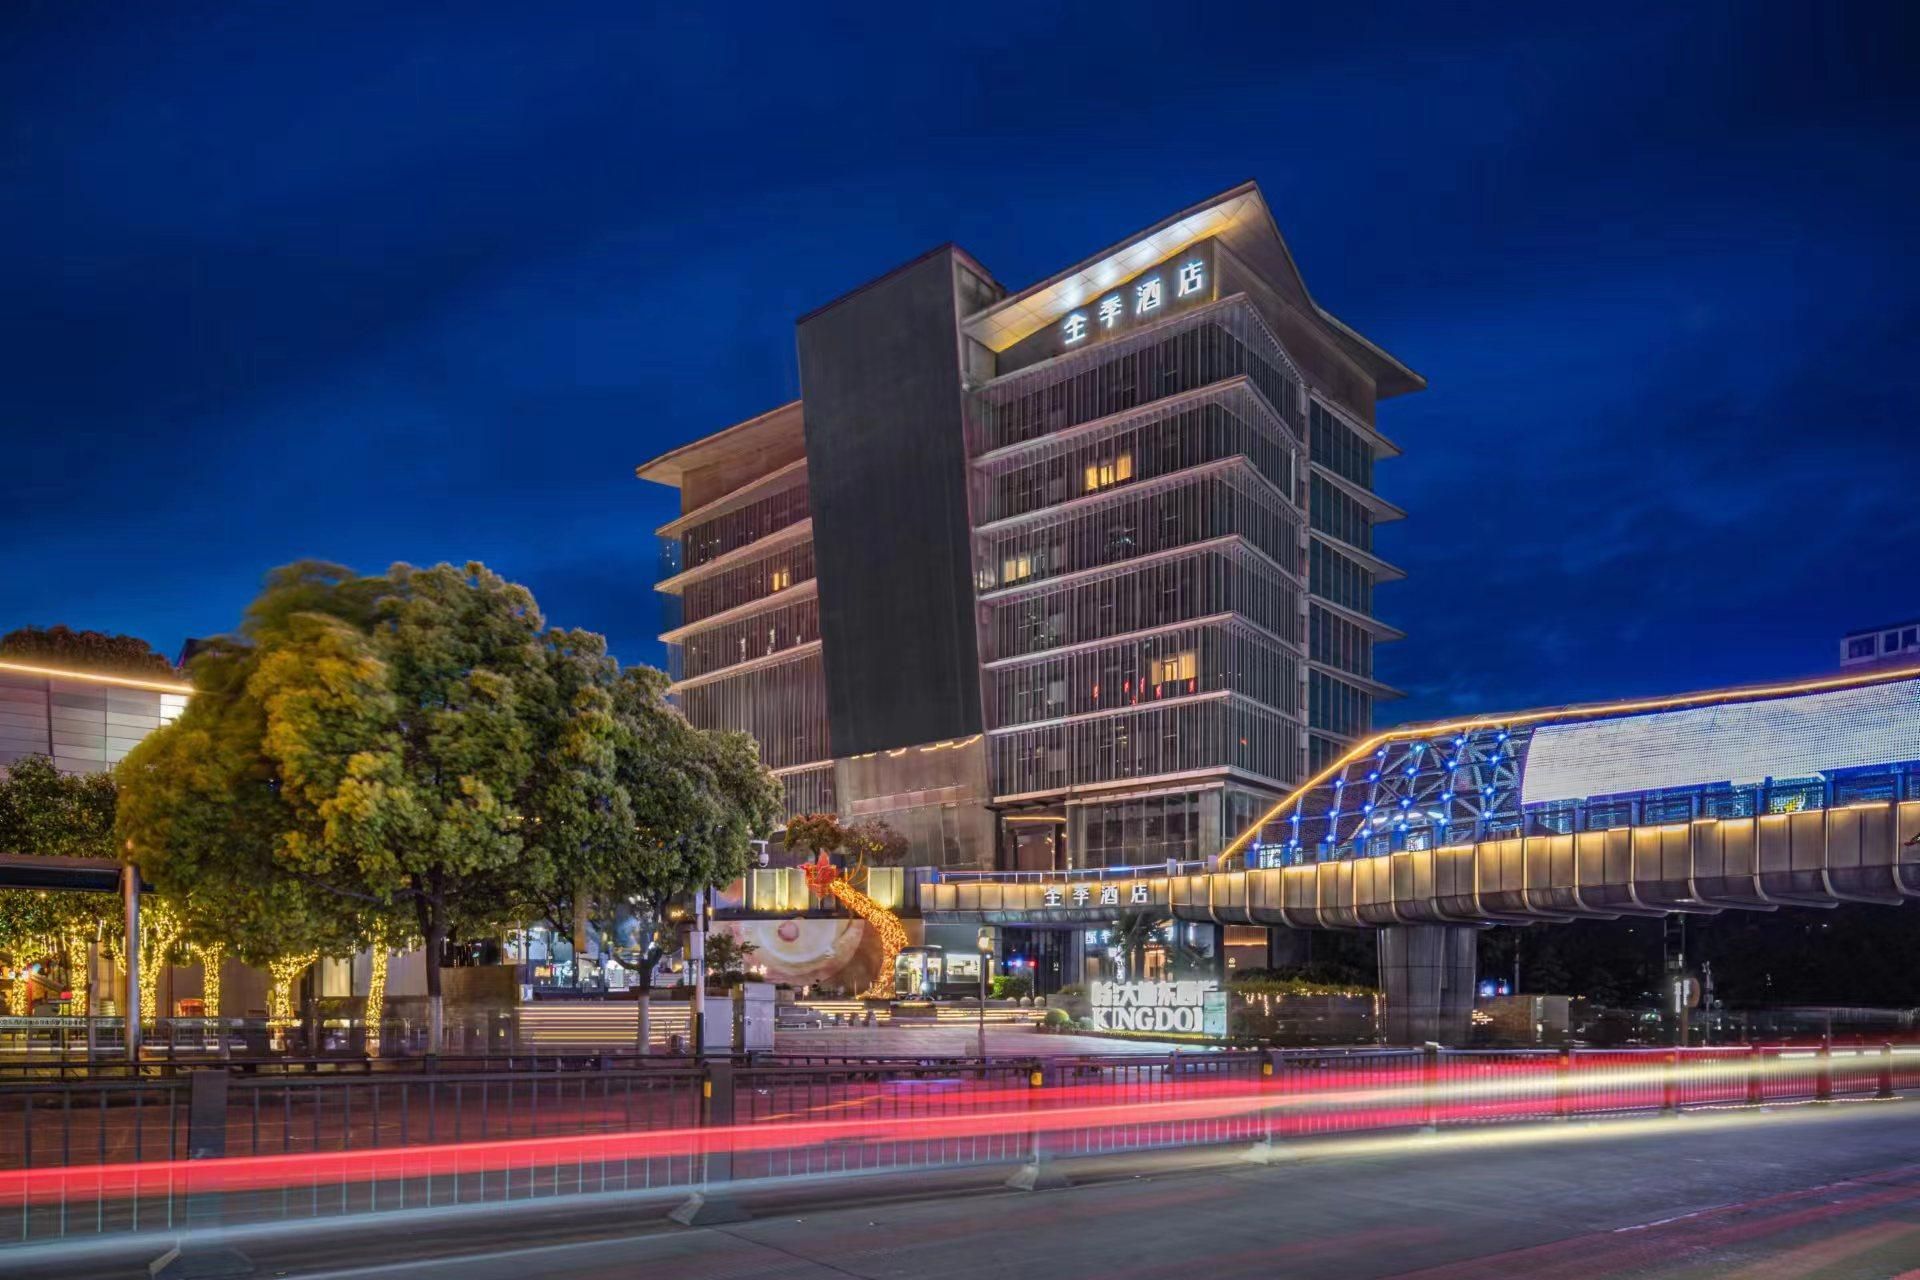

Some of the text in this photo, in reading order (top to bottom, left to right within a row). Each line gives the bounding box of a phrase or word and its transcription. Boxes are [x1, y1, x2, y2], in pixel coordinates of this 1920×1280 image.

[1063, 260, 1203, 344] 全季酒店
[1044, 884, 1148, 906] 全季酒店
